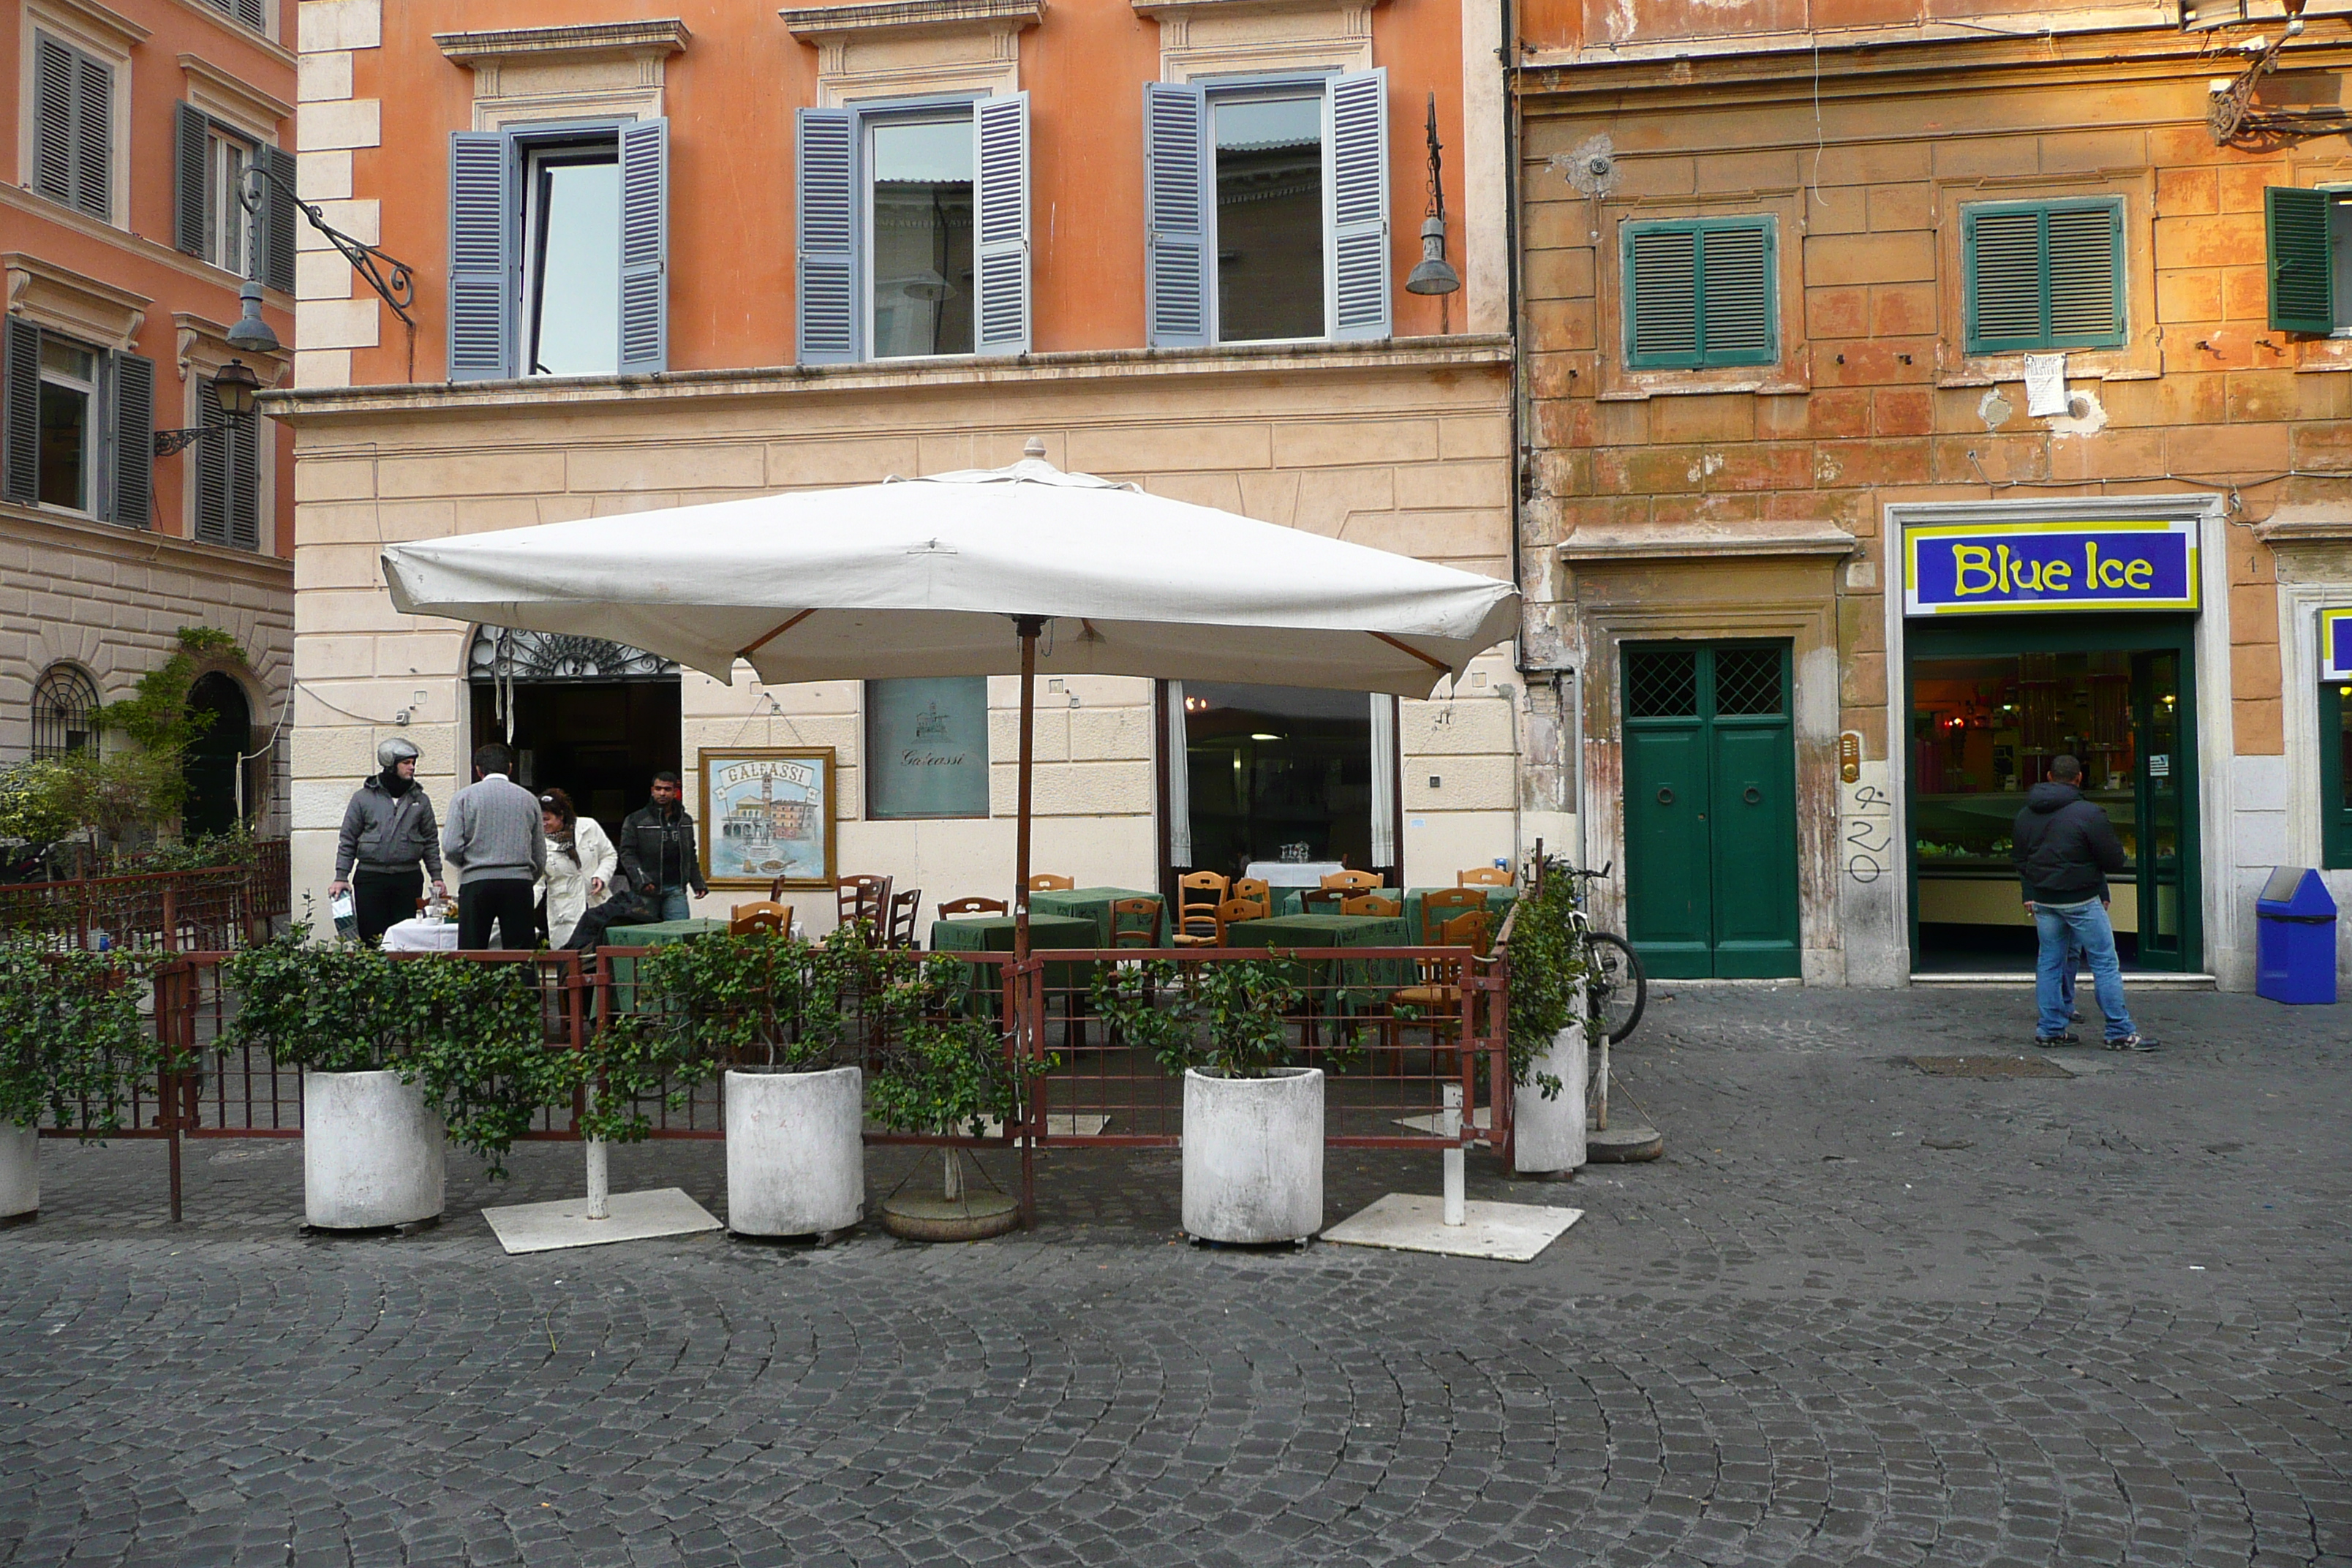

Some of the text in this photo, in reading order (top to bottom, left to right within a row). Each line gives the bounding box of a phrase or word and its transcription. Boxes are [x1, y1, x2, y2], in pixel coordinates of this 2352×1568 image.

[1952, 541, 2153, 596] Blue Ice
[2243, 556, 2259, 573] 4
[900, 748, 965, 766] Galeassi
[728, 762, 805, 783] GALEASSI
